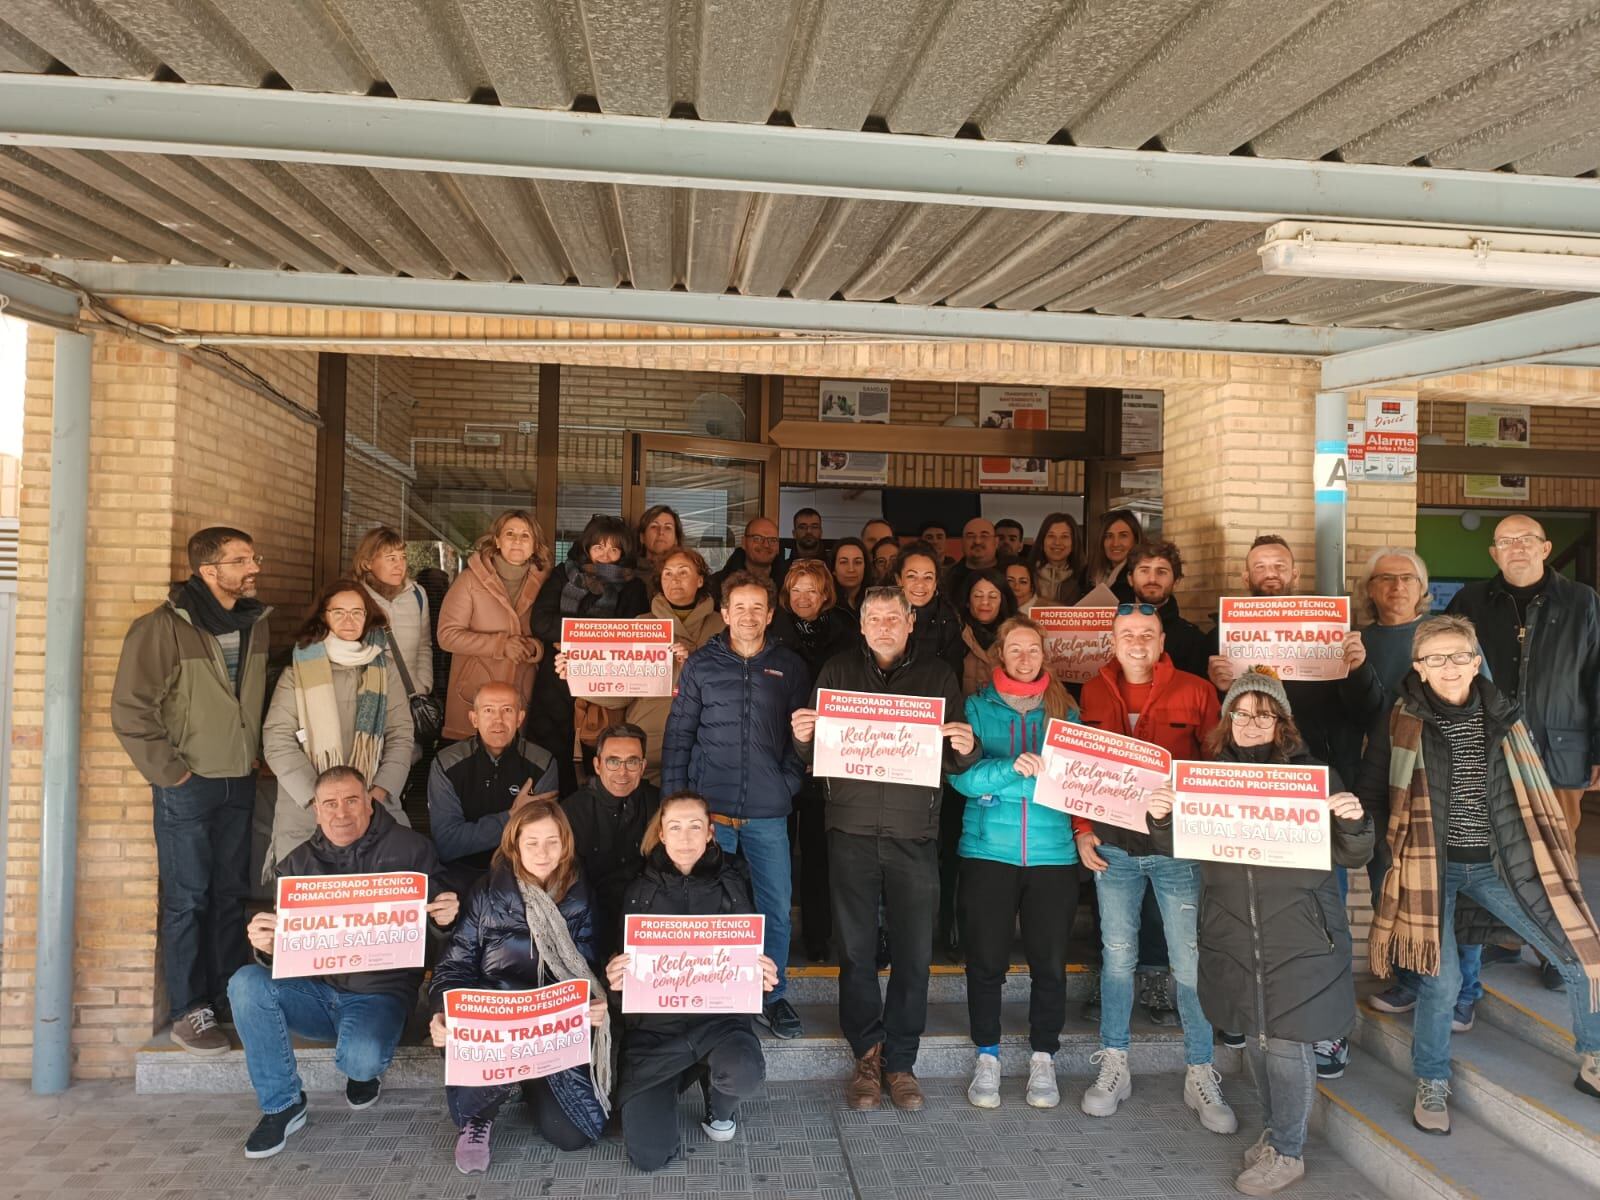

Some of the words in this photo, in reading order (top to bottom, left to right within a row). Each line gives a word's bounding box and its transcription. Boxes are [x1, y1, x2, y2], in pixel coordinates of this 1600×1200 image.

[1367, 434, 1414, 446] Alarma
[1325, 458, 1347, 487] A
[1299, 600, 1336, 608] TÉCNICO
[1096, 610, 1116, 618] TÉCN
[1228, 609, 1280, 617] FORMACIÓN
[1282, 610, 1342, 618] PROFESIONAL
[631, 622, 662, 630] TÉCNICO
[569, 630, 615, 638] FORMACIÓN
[1226, 630, 1271, 642] IGUAL
[1274, 630, 1344, 644] TRABAJO
[565, 650, 606, 661] IGUAL
[610, 650, 667, 663] TRABAJO
[1226, 647, 1273, 659] IGUAL
[1276, 647, 1345, 659] SALARIO
[610, 664, 668, 677] SALARIO
[1058, 669, 1081, 679] UGT
[588, 682, 613, 692] UGT
[831, 695, 893, 706] PROFESORADO
[895, 699, 931, 709] TÉCNICO
[824, 704, 876, 714] FORMACIÓN
[878, 707, 936, 719] PROFESIONAL
[841, 725, 896, 743] ¡Reclama
[898, 725, 912, 740] tu
[1061, 726, 1124, 747] PROFESORADO
[1125, 741, 1161, 757] TÉCNICO
[840, 742, 920, 761] complemento!
[1053, 734, 1106, 752] FORMACIÓN
[1107, 746, 1165, 768] PROFESIONAL
[845, 762, 872, 776] UGT
[1065, 760, 1121, 779] ¡Reclama
[1124, 768, 1138, 784] tu
[1190, 767, 1263, 779] PROFESORADO
[1267, 770, 1312, 781] TÉCNICO
[1062, 779, 1145, 800] complemento!
[1183, 777, 1244, 788] FORMACIÓN
[1247, 781, 1319, 792] PROFESIONAL
[1065, 797, 1093, 813] UGT
[1180, 801, 1234, 818] IGUAL
[1239, 805, 1320, 825] TRABAJO
[1181, 820, 1236, 838] IGUAL
[1241, 824, 1323, 843] SALARIO
[1212, 844, 1245, 858] UGT
[295, 880, 369, 891] PROFESORADO
[372, 877, 414, 886] TÉCNICO
[288, 890, 350, 901] FORMACIÓN
[353, 886, 419, 897] PROFESIONAL
[283, 916, 338, 932] IGUAL
[343, 909, 419, 928] TRABAJO
[641, 920, 709, 929] PROFESORADO
[711, 919, 750, 928] TÉCNICO
[282, 934, 339, 951] IGUAL
[343, 929, 419, 948] SALARIO
[634, 930, 690, 939] FORMACIÓN
[693, 931, 756, 939] PROFESIONAL
[313, 956, 347, 969] UGT
[652, 951, 713, 974] ¡Reclama
[716, 949, 731, 963] tu
[653, 965, 740, 992] complemento!
[461, 994, 532, 1004] PROFESORADO
[534, 984, 576, 1000] TÉCNICO
[455, 1004, 514, 1015] FORMACIÓN
[516, 992, 581, 1013] PROFESIONAL
[658, 996, 688, 1008] UGT
[453, 1027, 504, 1043] IGUAL
[508, 1014, 583, 1041] TRABAJO
[454, 1044, 506, 1062] IGUAL
[511, 1032, 584, 1060] SALARIO
[483, 1067, 515, 1081] UGT
